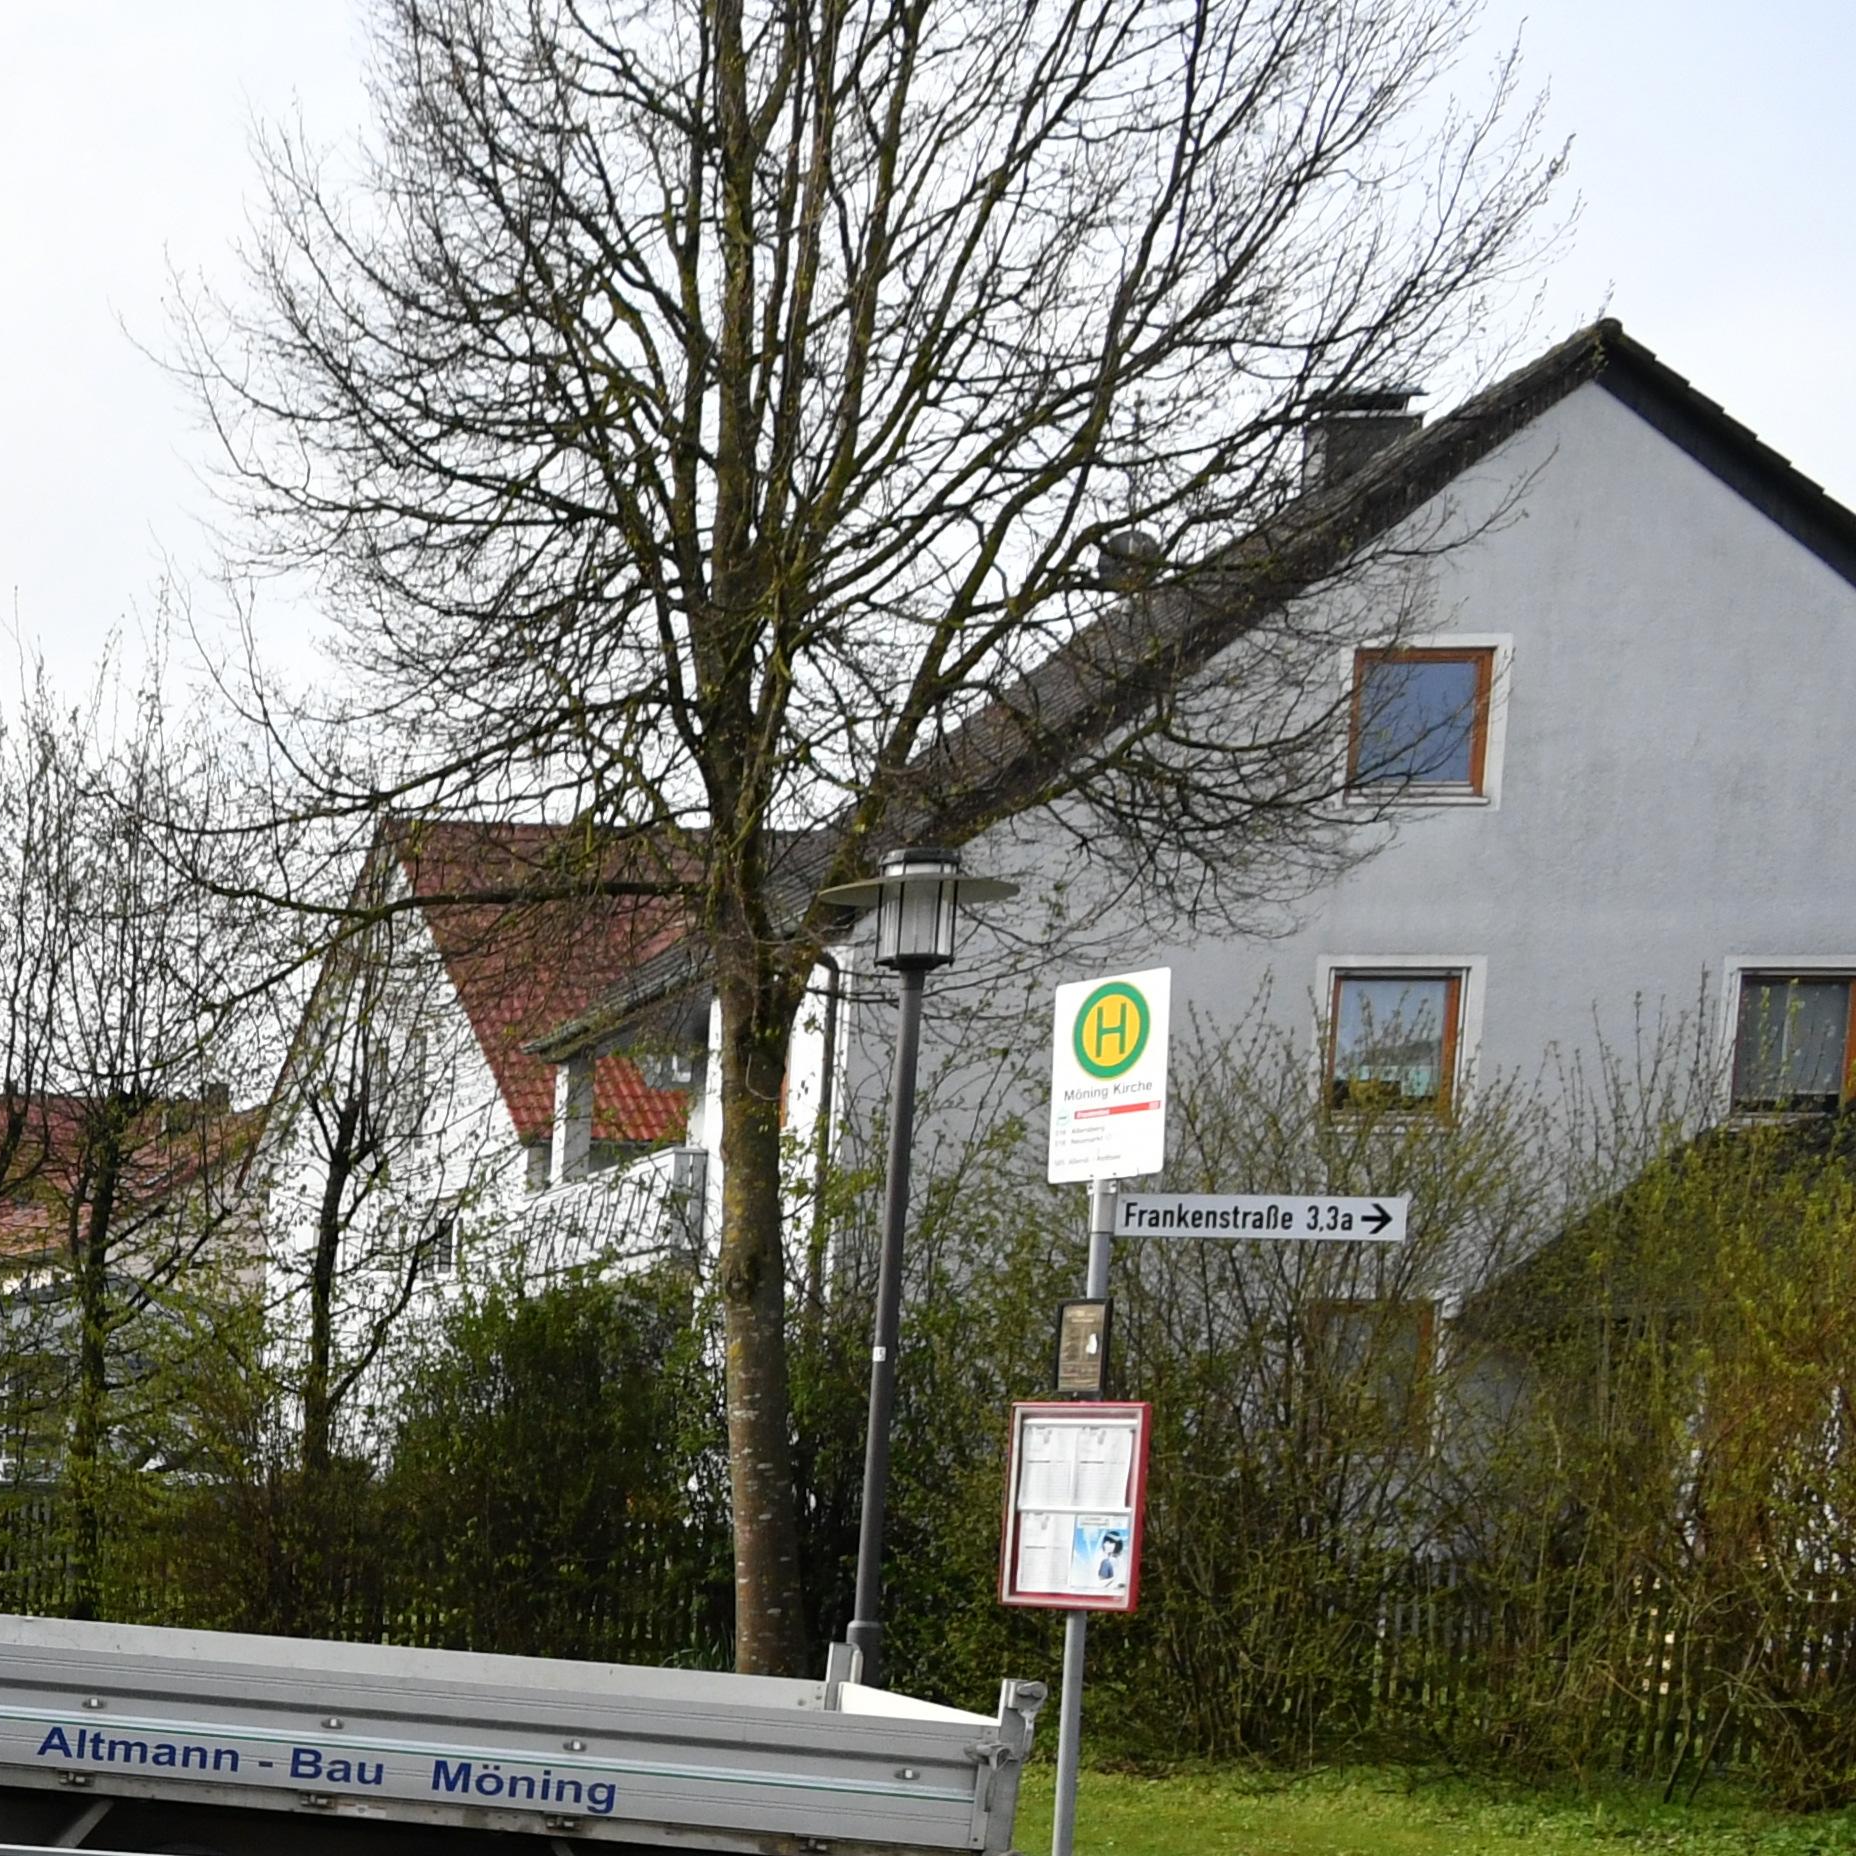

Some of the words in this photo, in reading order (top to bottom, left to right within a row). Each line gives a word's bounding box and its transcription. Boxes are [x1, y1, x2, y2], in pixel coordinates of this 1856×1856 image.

[1095, 1002, 1127, 1059] H
[1064, 1087, 1108, 1102] Möning
[1113, 1080, 1152, 1095] Kirche
[1124, 1201, 1293, 1230] Frankenstraße
[1306, 1204, 1353, 1232] 3,3a
[37, 1726, 239, 1773] Altmann
[289, 1746, 384, 1785] Bau
[431, 1759, 616, 1815] Möning
